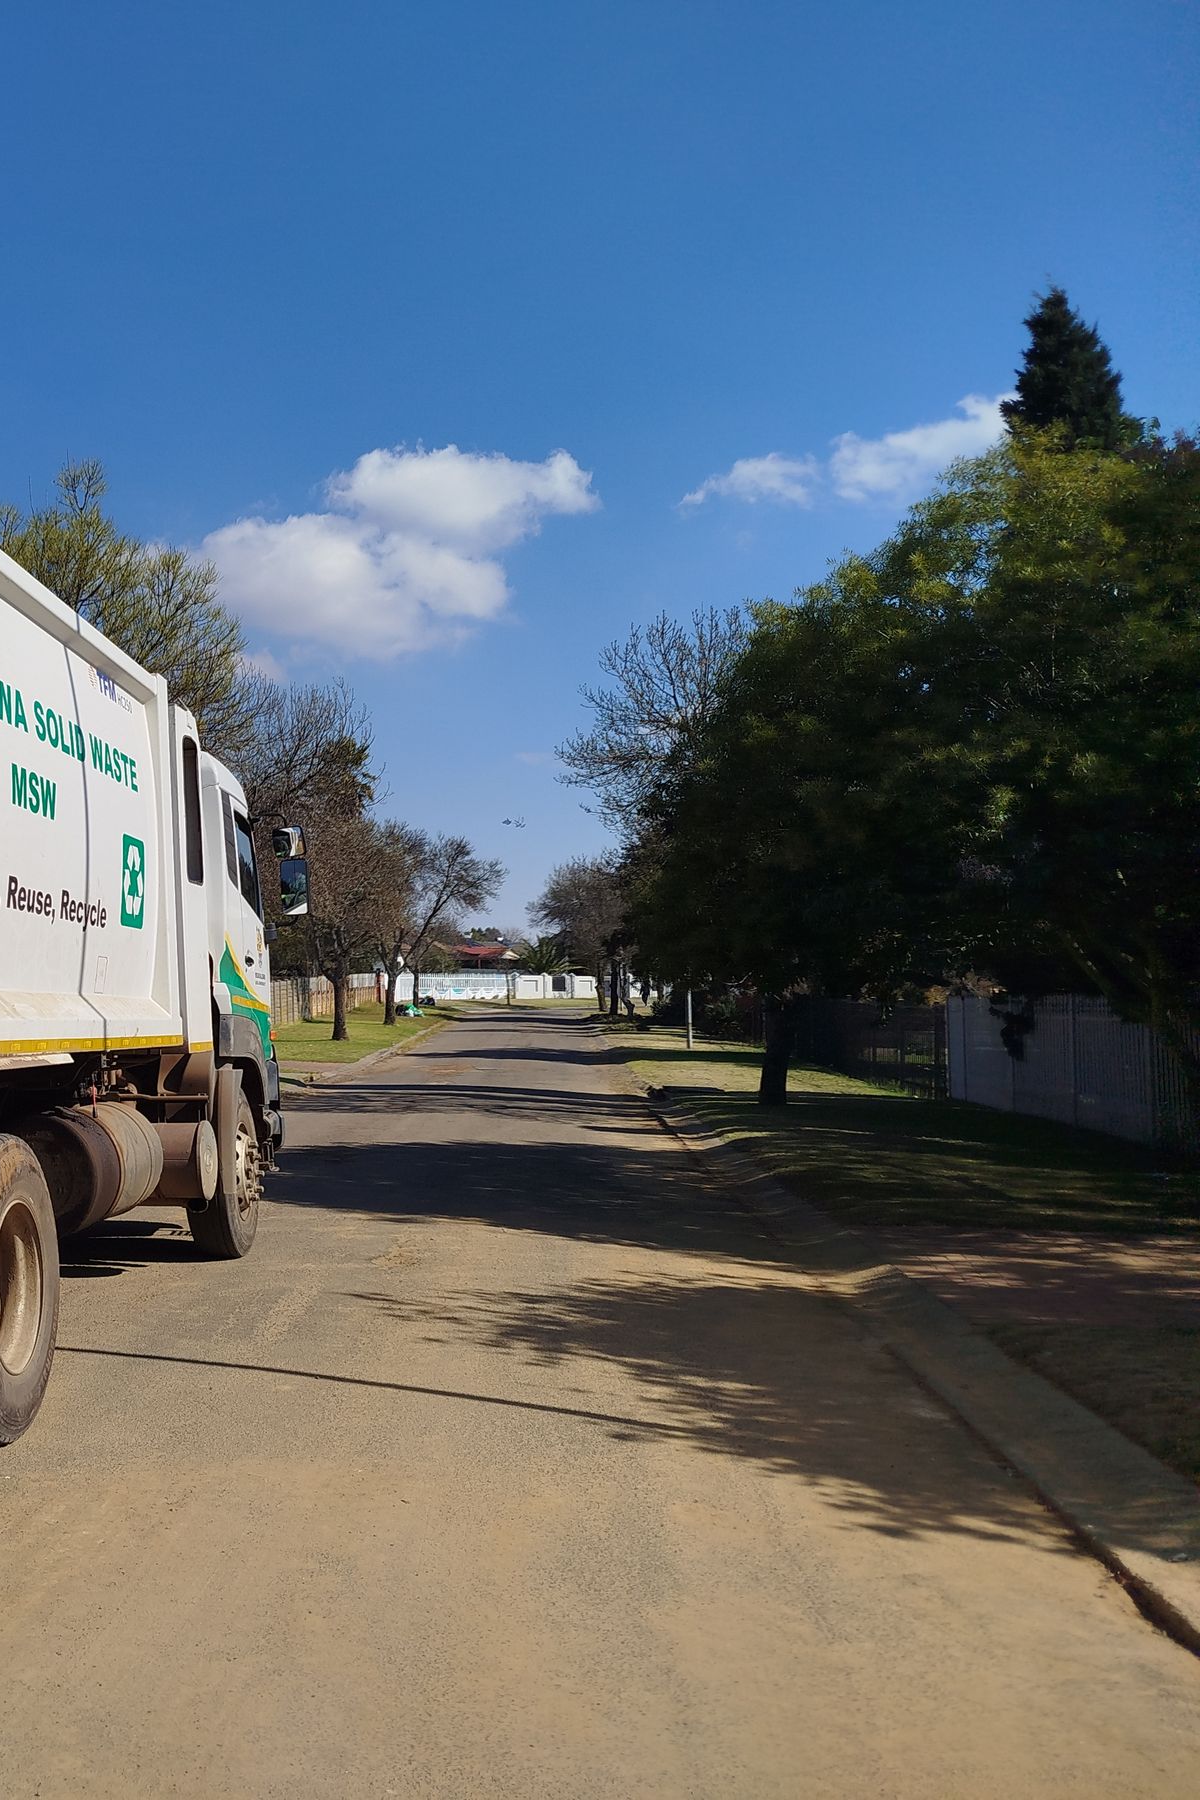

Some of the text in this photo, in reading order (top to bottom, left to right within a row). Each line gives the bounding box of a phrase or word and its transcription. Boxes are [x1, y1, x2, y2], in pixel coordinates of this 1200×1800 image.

[34, 700, 86, 762] SOLID
[89, 733, 139, 793] WASTE
[11, 763, 57, 820] MSW
[6, 875, 56, 925] Reuse,
[60, 889, 107, 932] Recycle
